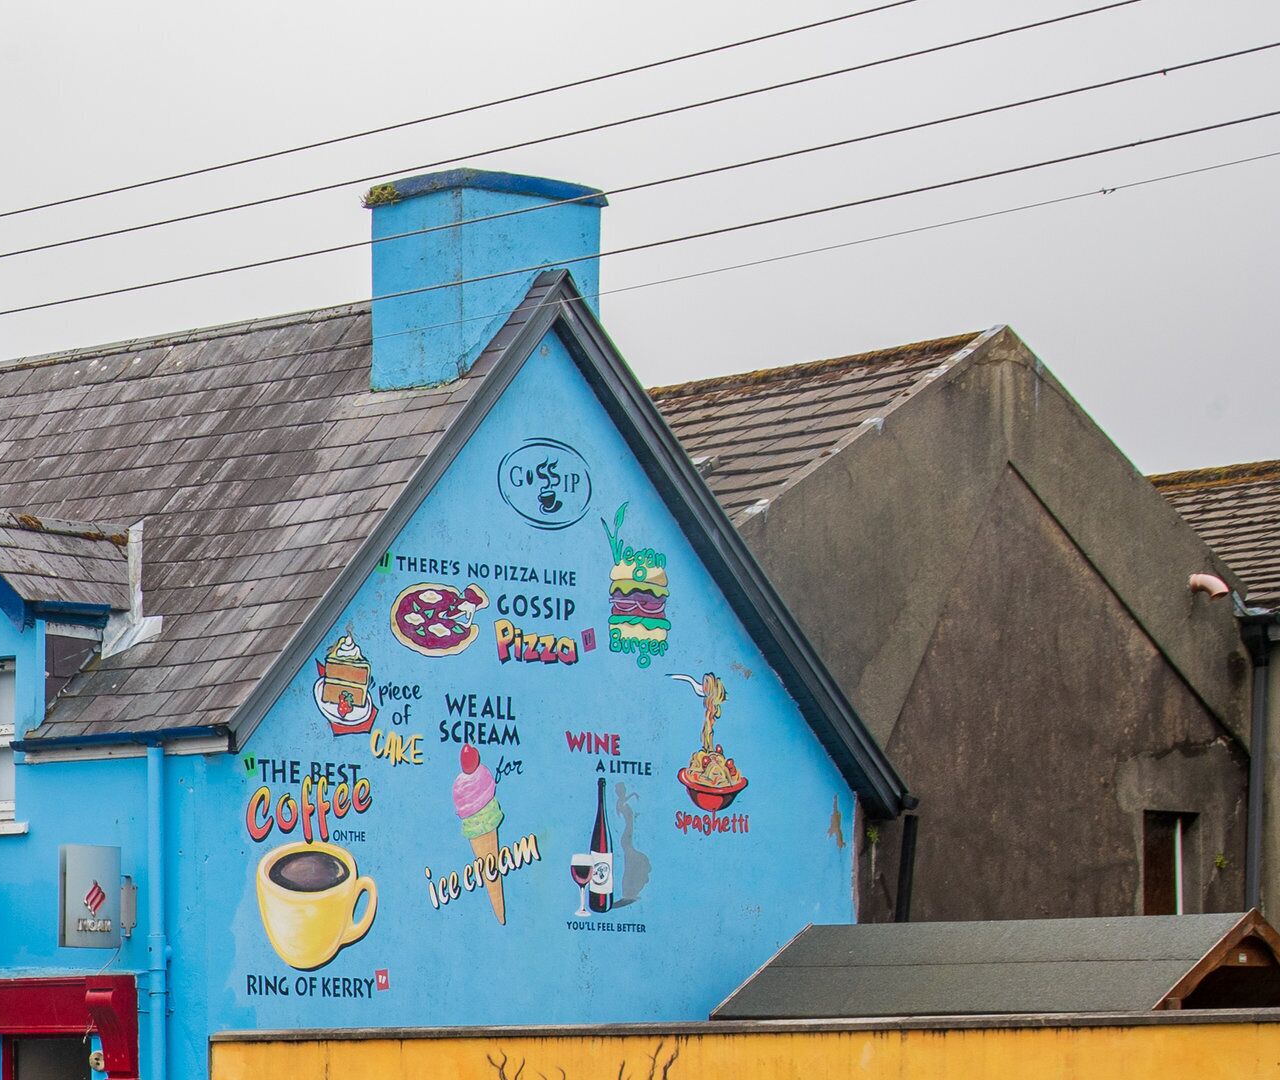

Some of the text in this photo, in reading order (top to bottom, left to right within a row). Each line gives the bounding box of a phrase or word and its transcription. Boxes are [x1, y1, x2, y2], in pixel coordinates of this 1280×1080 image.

[609, 534, 667, 582] Vegan
[467, 562, 490, 579] NO
[495, 565, 539, 583] PIZZA
[544, 569, 576, 586] LIKE
[497, 595, 575, 621] GOSSIP
[609, 628, 669, 669] Burger
[379, 681, 423, 704] piece
[392, 703, 412, 728] of
[444, 693, 516, 721] WE ALL
[440, 720, 520, 746] SCREAM
[565, 731, 621, 757] WINE
[371, 731, 424, 765] CAKE
[311, 760, 360, 785] BEST
[495, 756, 524, 783] for
[596, 759, 652, 776] A LITTLE
[245, 772, 372, 842] Coffee
[333, 830, 365, 842] ON THE
[674, 809, 749, 837] Spaghetti
[427, 833, 540, 909] ice cream
[567, 921, 646, 933] YOU'LL FEEL BETTER
[247, 975, 289, 998] RING
[296, 976, 317, 996] OF
